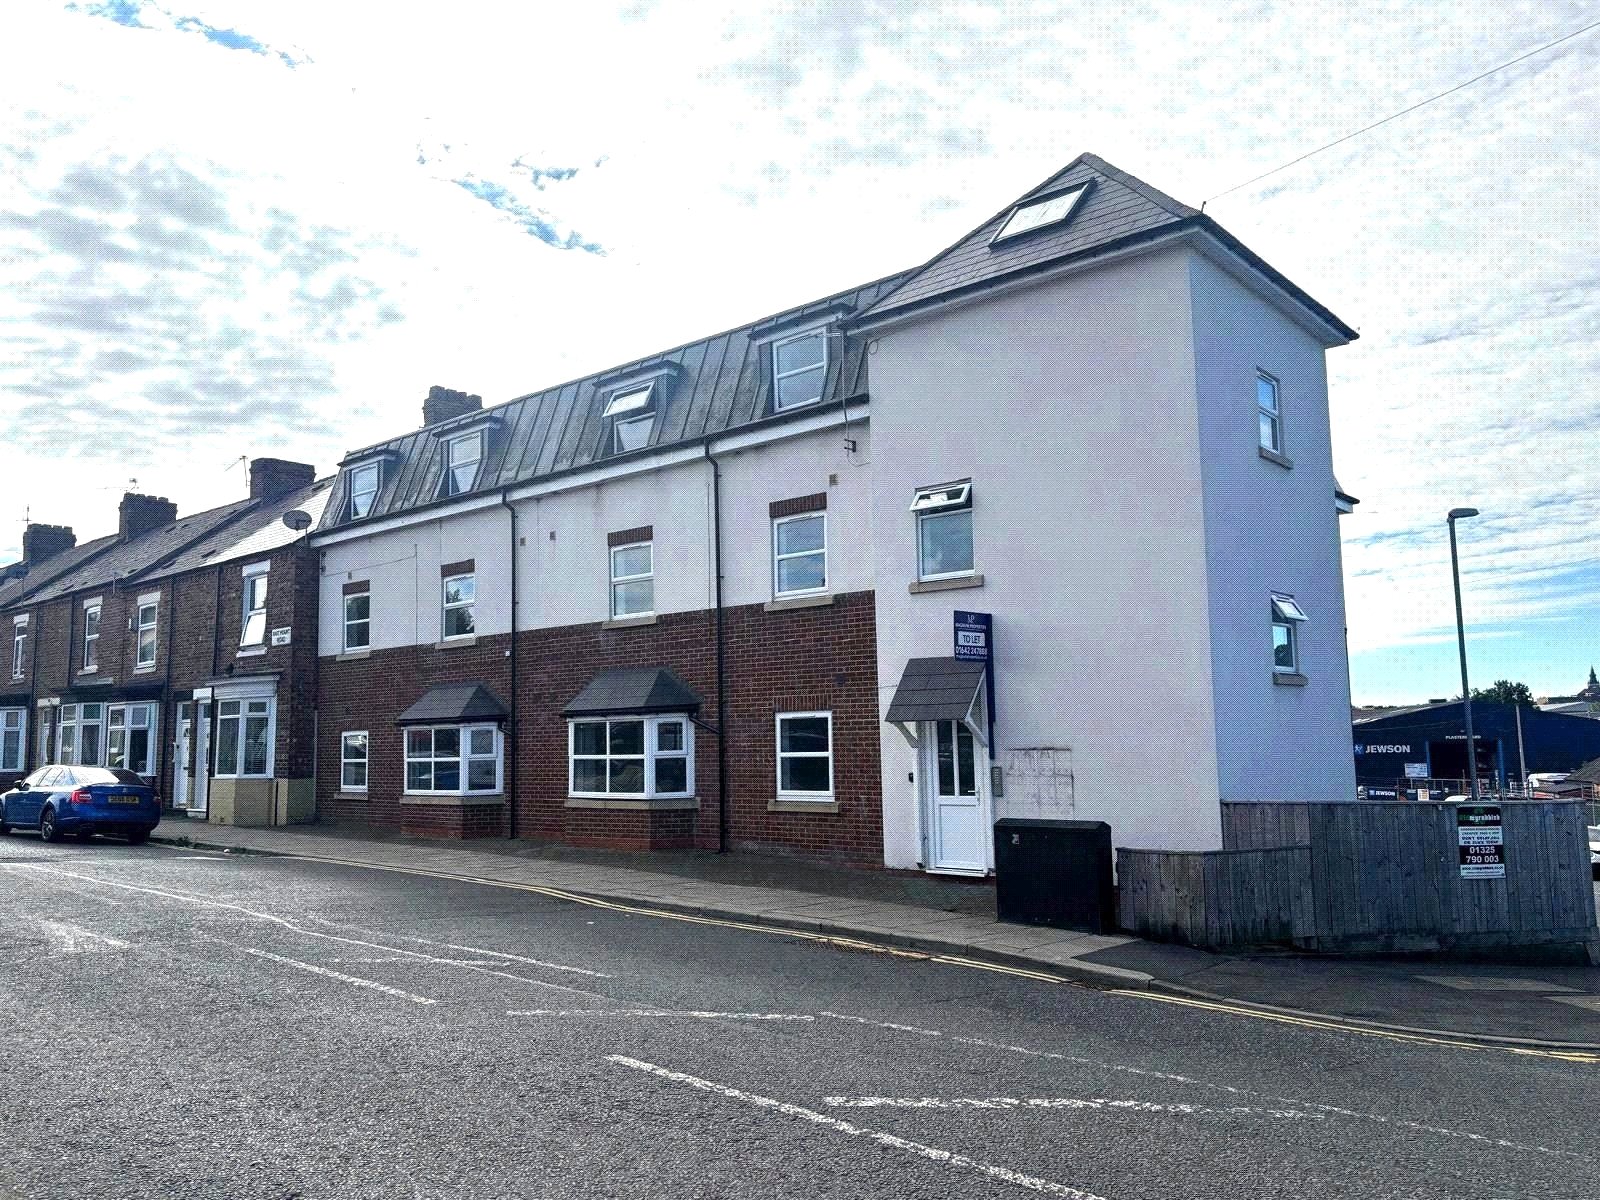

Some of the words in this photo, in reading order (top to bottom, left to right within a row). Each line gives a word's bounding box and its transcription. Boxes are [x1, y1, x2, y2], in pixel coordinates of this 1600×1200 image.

[962, 634, 971, 643] TO
[971, 635, 982, 644] LET
[1365, 744, 1411, 753] JEWSON
[1469, 846, 1496, 854] 01325
[1465, 855, 1482, 863] 790
[1484, 855, 1499, 863] 003
